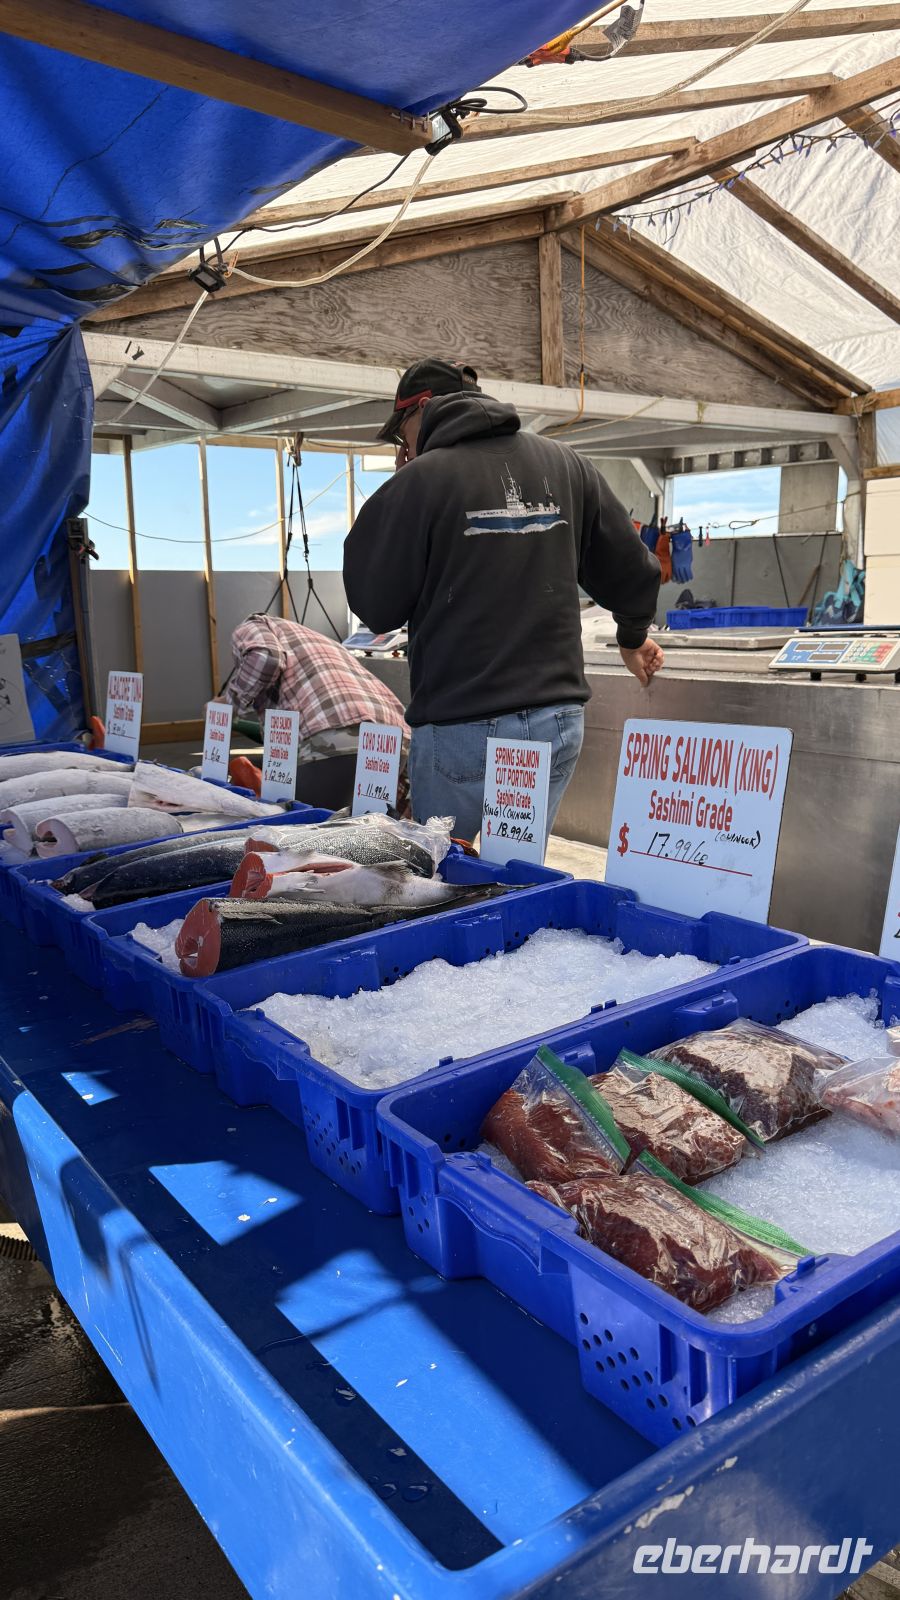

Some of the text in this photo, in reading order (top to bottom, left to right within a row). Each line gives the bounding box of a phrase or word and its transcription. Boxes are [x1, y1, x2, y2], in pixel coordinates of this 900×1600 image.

[279, 716, 292, 730] SALMON
[362, 731, 397, 755] COHO SALMON
[365, 756, 390, 774] Sashimi Grade
[495, 746, 540, 769] SPRING SALMON
[623, 732, 780, 800] SPRING SALMON (KING)
[495, 767, 537, 789] CUT PORTIONS
[496, 788, 531, 809] Sashimi Grade
[648, 789, 733, 831] Sashimi Grade
[486, 819, 491, 837] $
[617, 822, 630, 857] $
